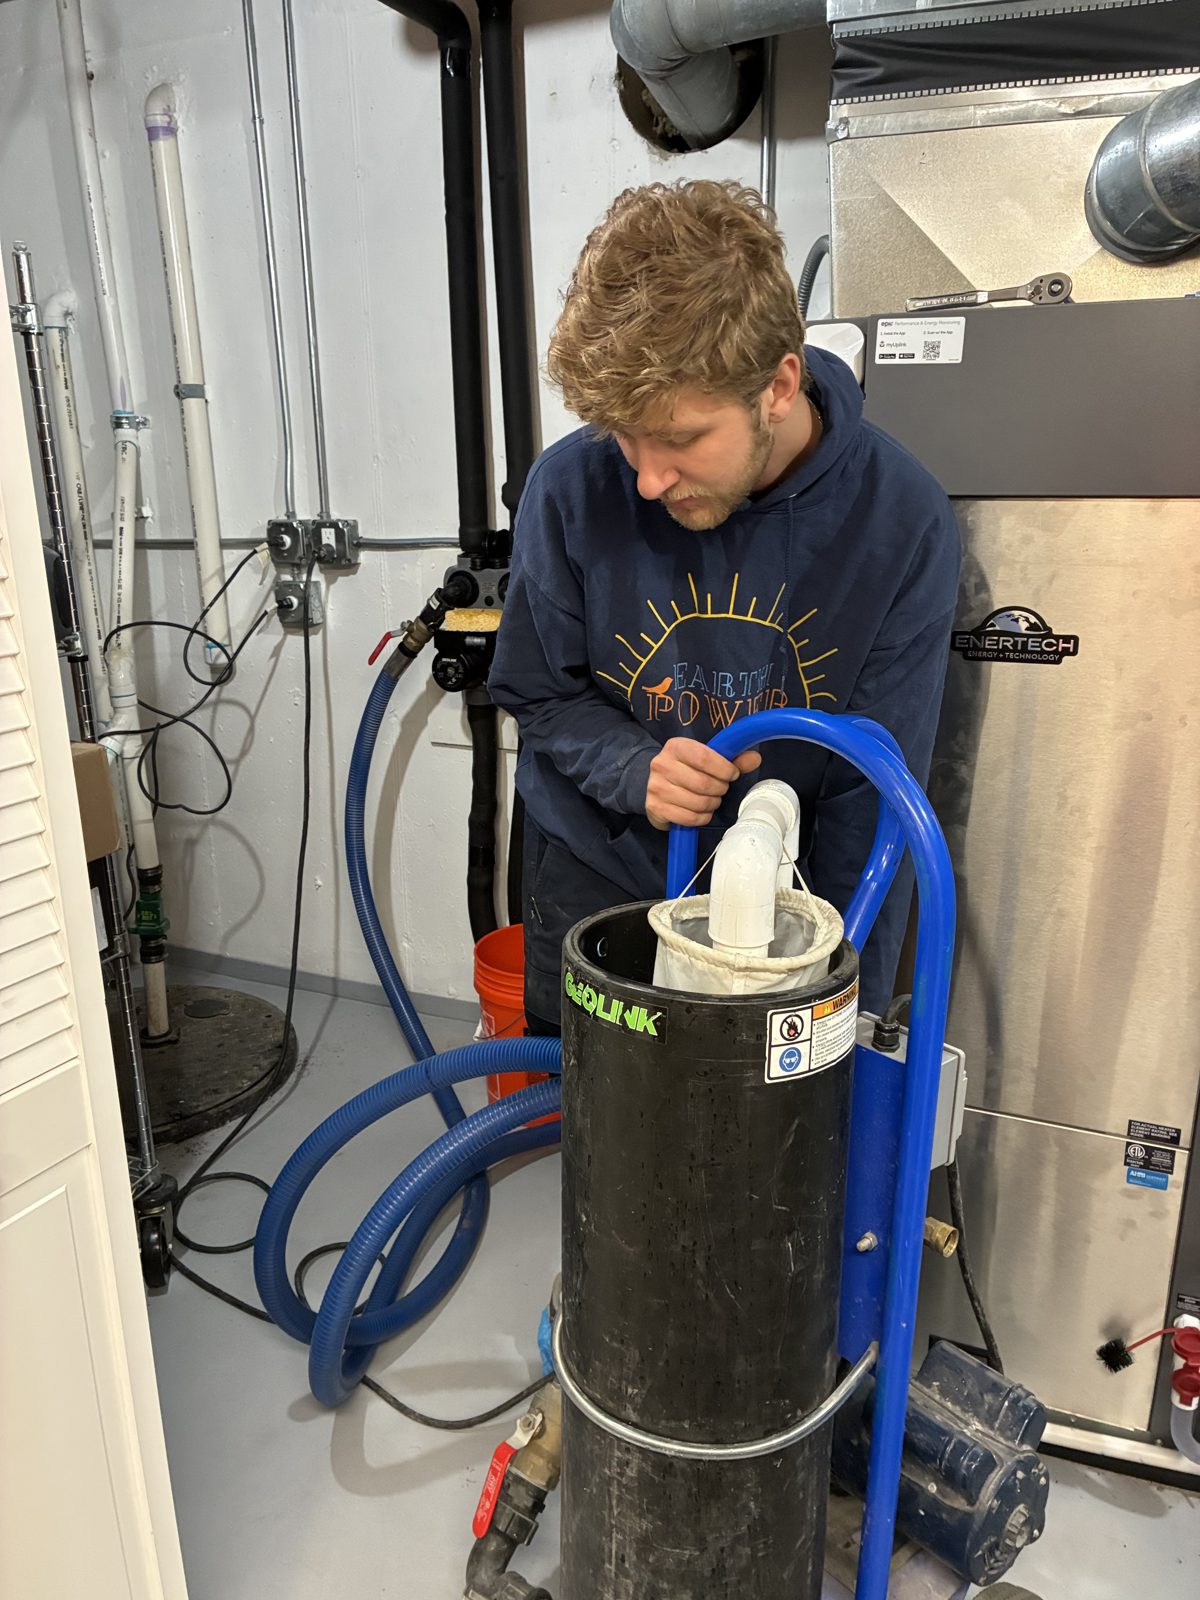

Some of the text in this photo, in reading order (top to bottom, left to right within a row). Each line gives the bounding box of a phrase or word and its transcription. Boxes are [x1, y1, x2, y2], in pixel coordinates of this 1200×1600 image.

[955, 635, 1074, 653] ENERTECH
[967, 651, 998, 659] ENERGY
[1005, 652, 1060, 661] TECHNOLOGY
[673, 662, 774, 698] EARTH
[646, 688, 789, 729] POWER
